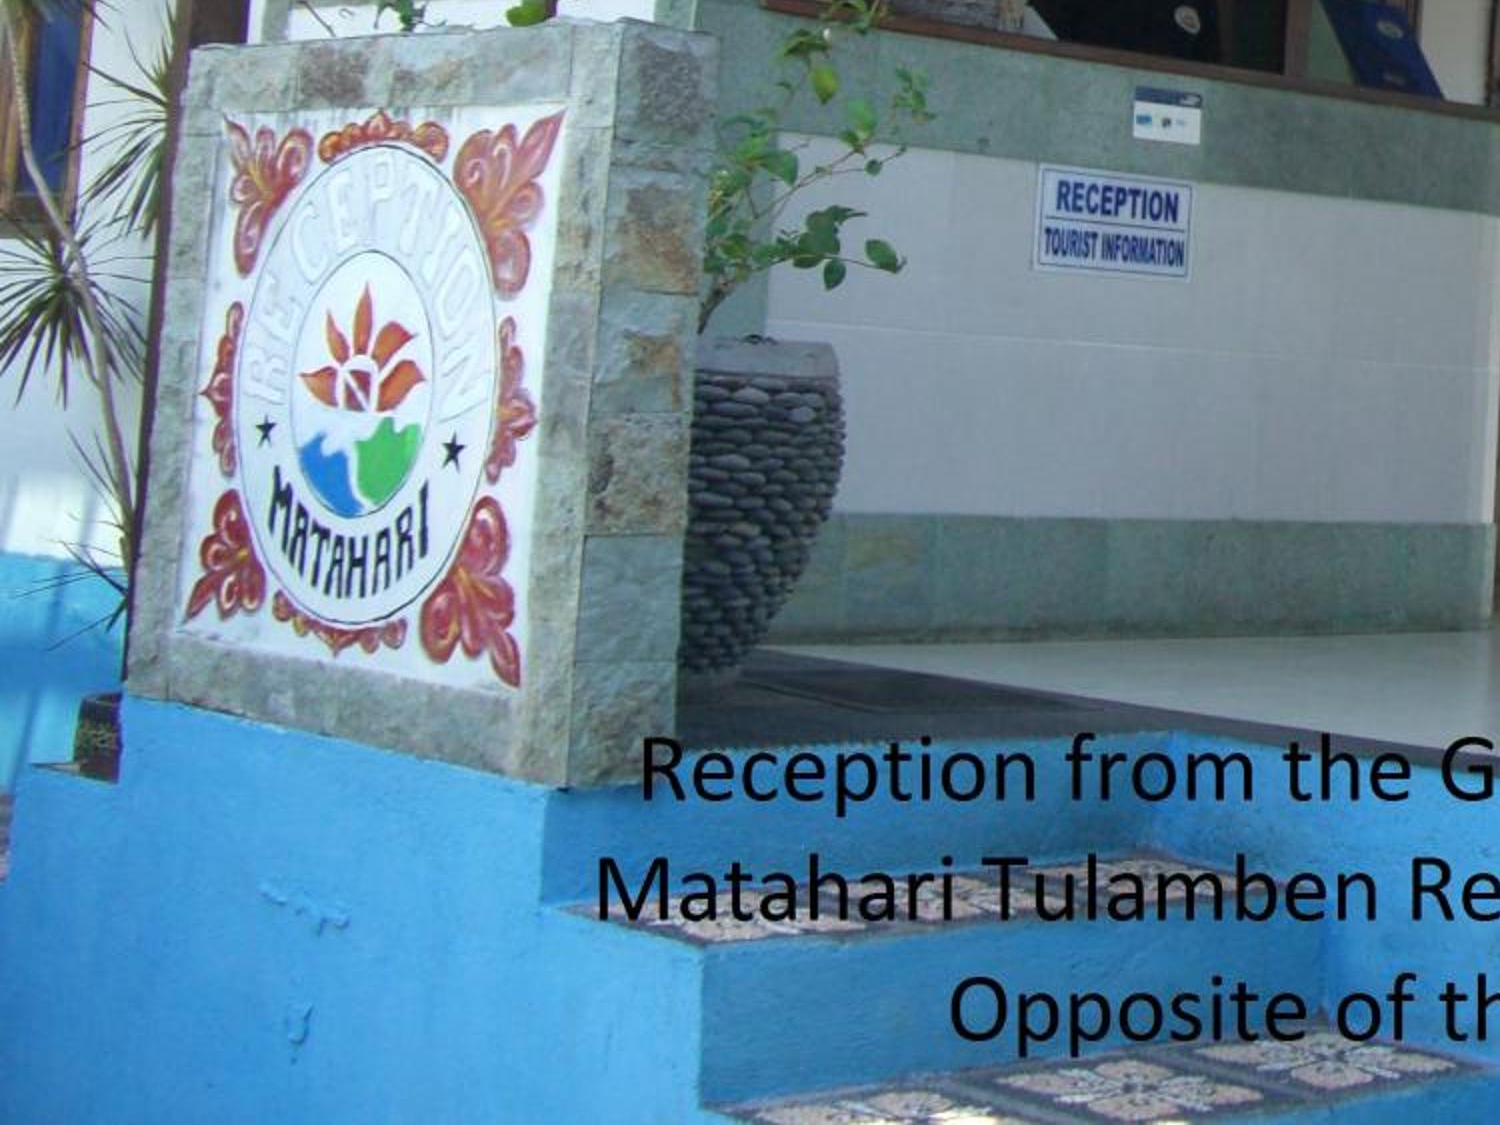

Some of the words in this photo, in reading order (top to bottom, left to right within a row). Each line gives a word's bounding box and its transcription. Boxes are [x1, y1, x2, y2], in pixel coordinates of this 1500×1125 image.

[1056, 179, 1180, 223] RECEPTION
[243, 150, 493, 424] RECEPTION
[1044, 226, 1098, 260] TOURIST
[1101, 231, 1185, 268] INFORMATION
[268, 463, 430, 600] MATAHARI
